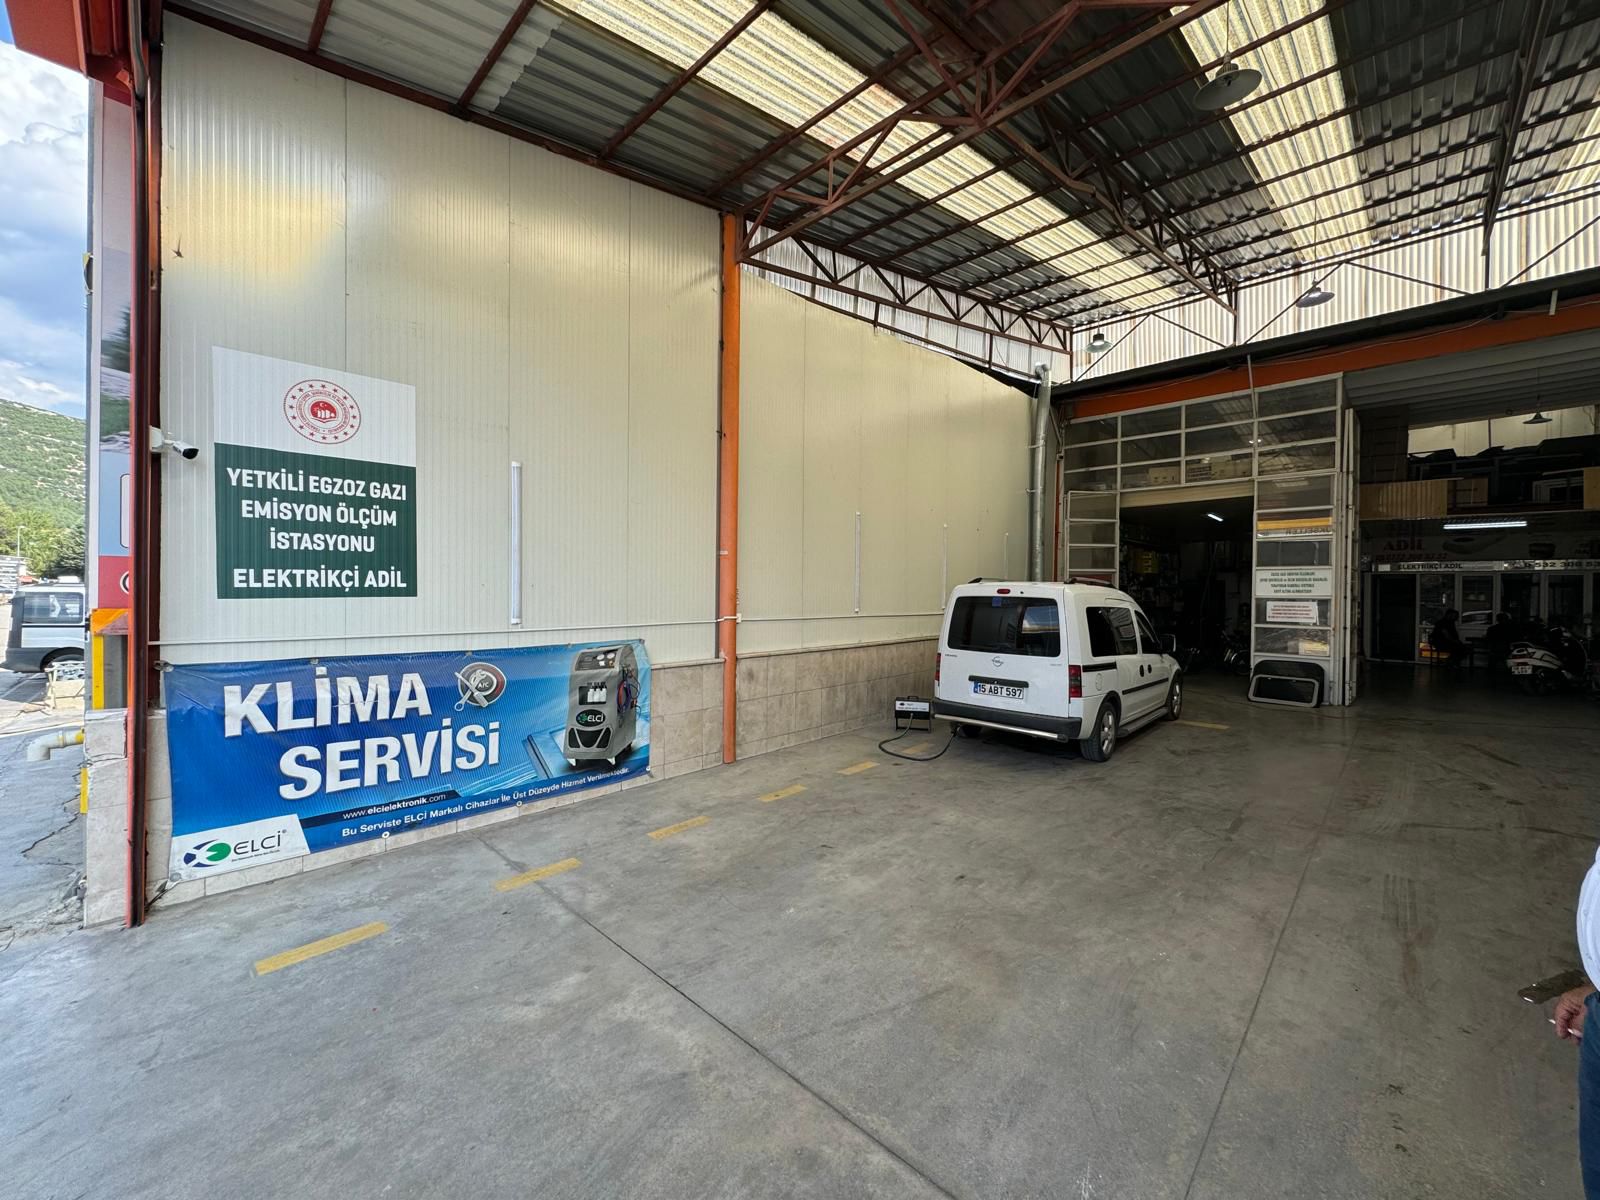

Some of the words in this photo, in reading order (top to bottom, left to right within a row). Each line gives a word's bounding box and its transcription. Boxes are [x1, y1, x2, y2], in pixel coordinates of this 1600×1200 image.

[226, 467, 304, 492] YETKİLİ
[309, 476, 366, 497] EGZOZ
[370, 482, 407, 500] GAZI
[241, 497, 332, 522] EMİSYON
[336, 503, 397, 529] ÖLÇÜM
[270, 527, 375, 552] İSTASYONU
[233, 565, 359, 592] ELEKTRİKÇİ
[364, 566, 407, 588] ADİL
[223, 666, 433, 738] KLİMA
[978, 684, 987, 693] 15
[988, 685, 1004, 696] ABT
[1005, 687, 1023, 698] 597
[341, 828, 357, 837] Bu
[360, 819, 402, 833] Serviste
[404, 810, 427, 824] ELCİ
[429, 804, 463, 818] Markalı
[465, 797, 500, 810] Cihazlar
[501, 793, 511, 802] İle
[512, 791, 527, 800] Üst
[528, 784, 560, 796] Düzeyde
[561, 777, 586, 789] Hizmet
[342, 793, 446, 820] www.elcielektronik.com
